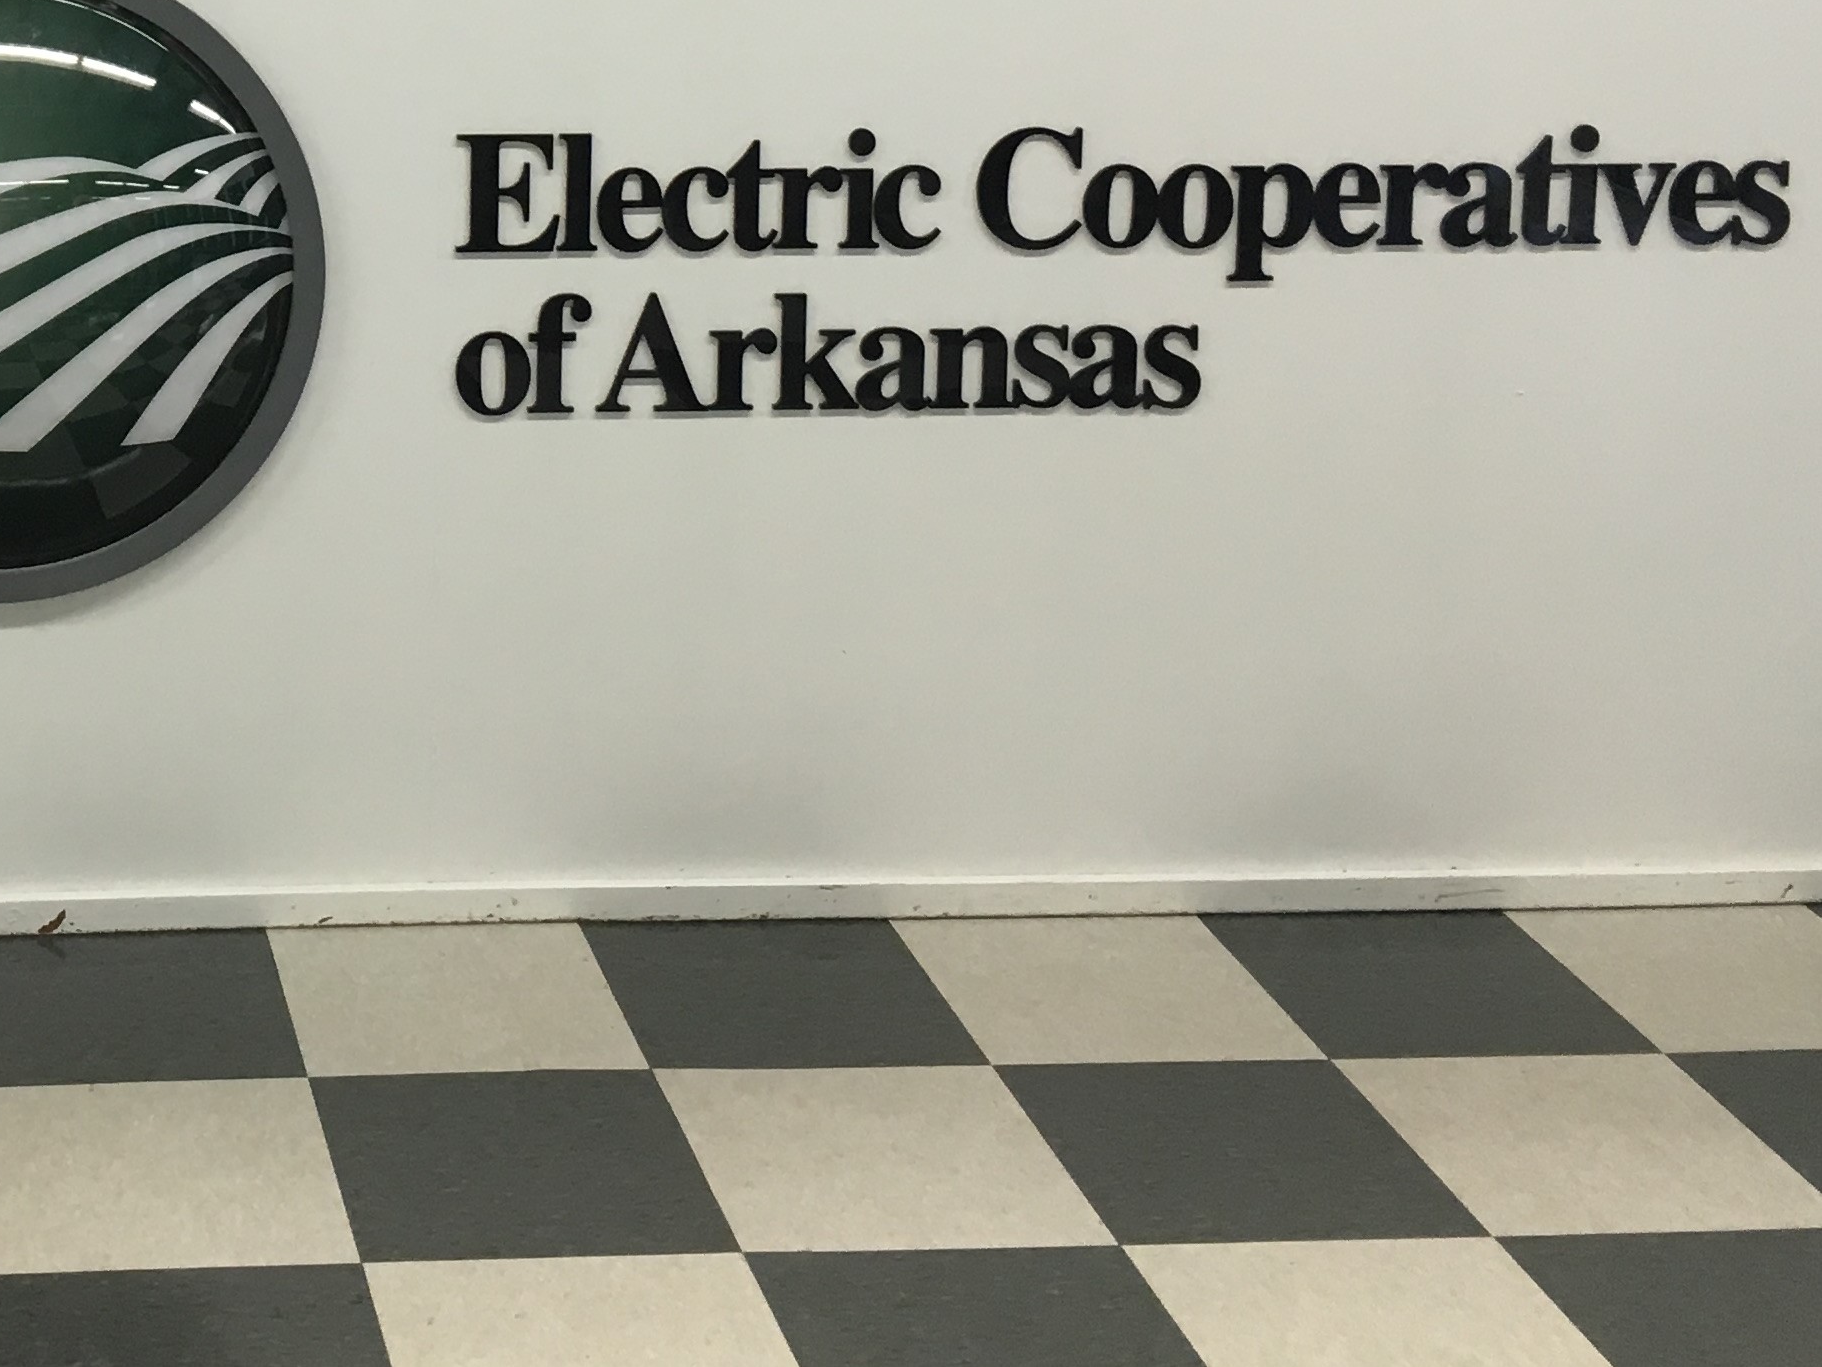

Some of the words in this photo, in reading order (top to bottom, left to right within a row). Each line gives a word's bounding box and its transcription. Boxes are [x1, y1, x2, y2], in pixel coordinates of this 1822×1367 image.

[455, 126, 942, 254] Electric
[976, 123, 1793, 283] Cooperatives
[454, 292, 593, 416] of
[594, 291, 1202, 413] Arkansas
